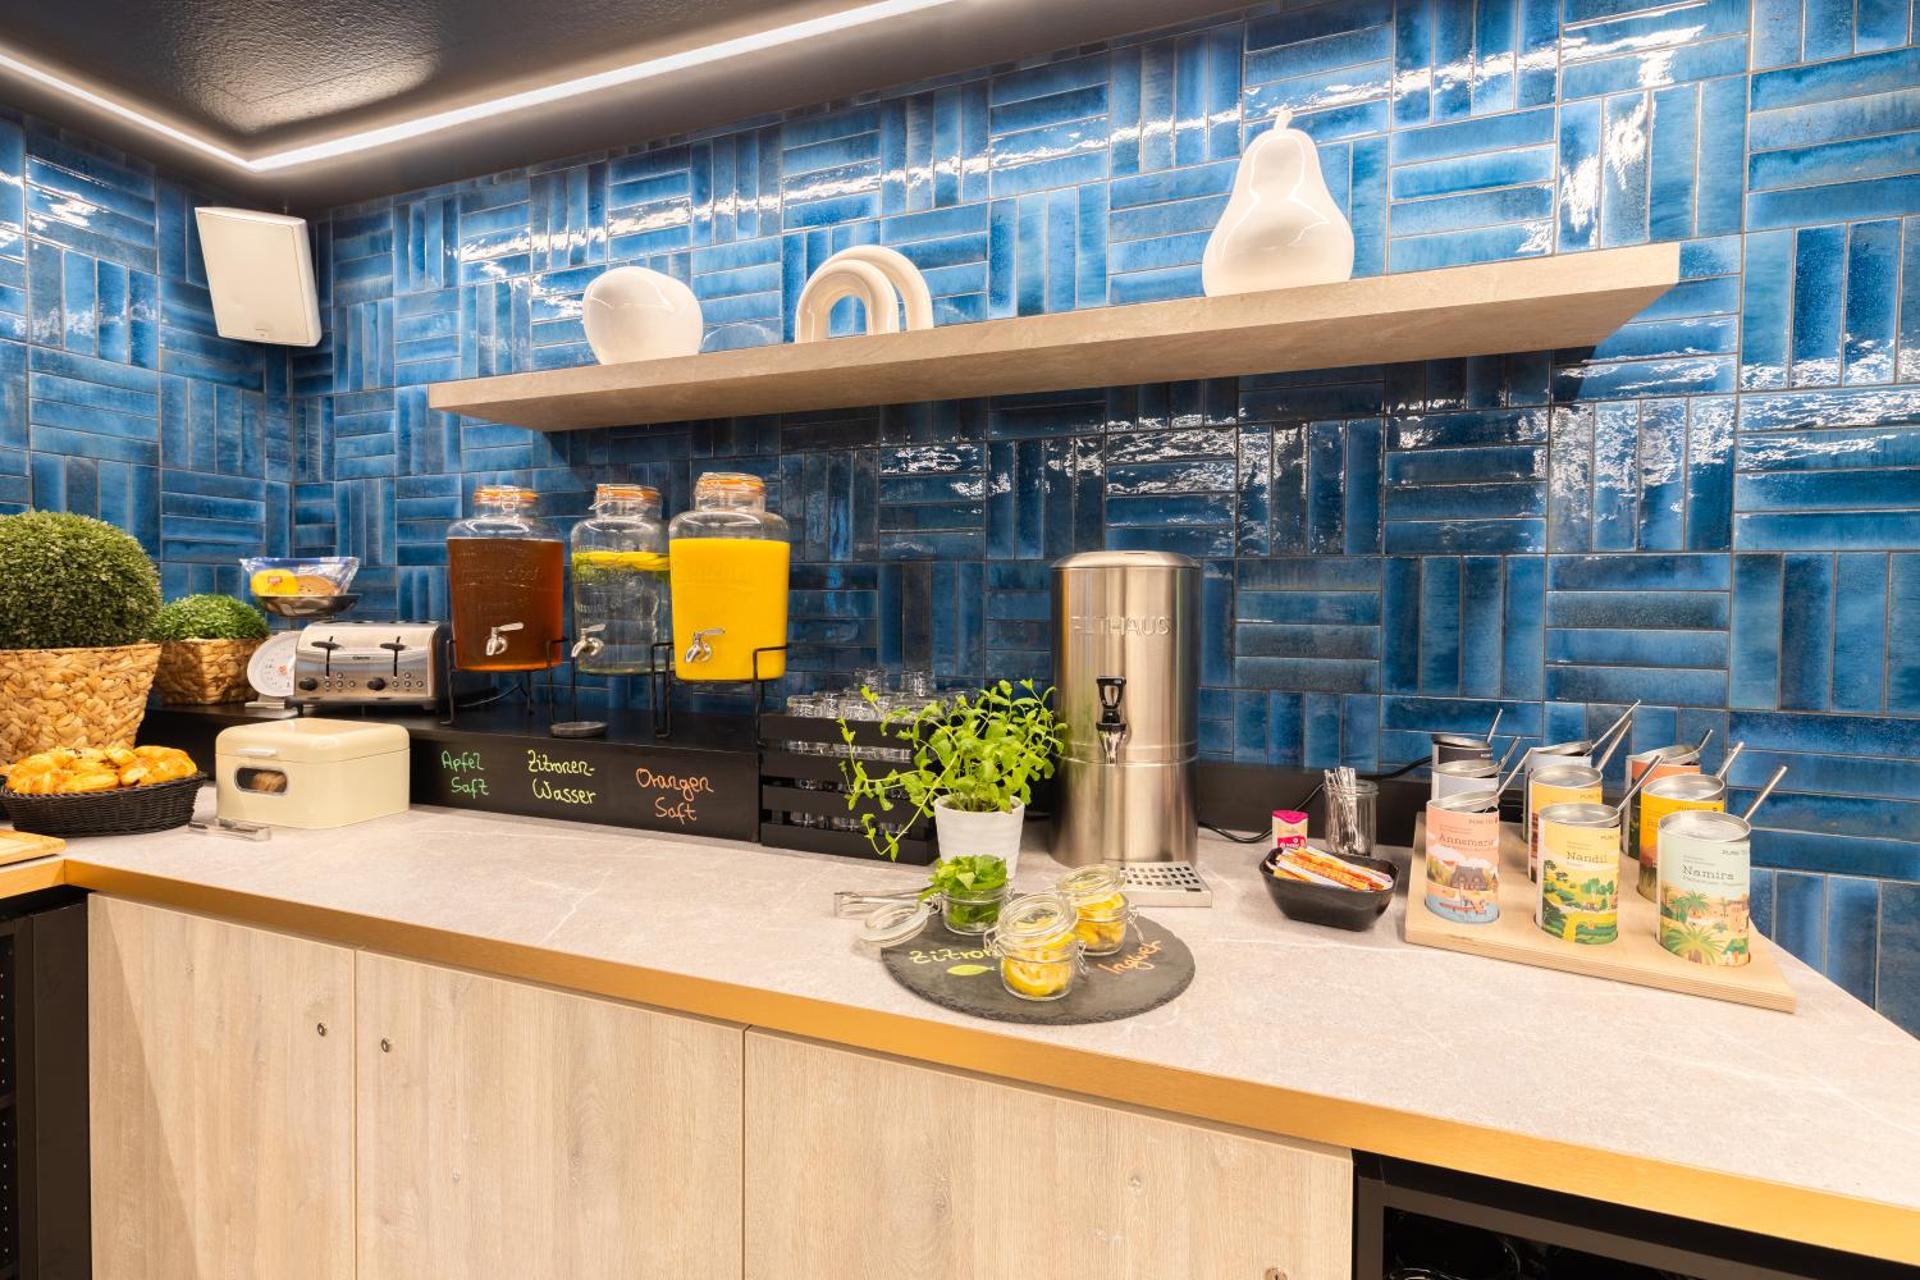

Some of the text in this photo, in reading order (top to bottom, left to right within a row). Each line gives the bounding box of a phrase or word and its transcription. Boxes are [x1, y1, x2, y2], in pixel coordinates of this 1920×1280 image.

[441, 751, 484, 770] Apfel
[528, 750, 595, 776] Zitronen-
[451, 777, 489, 799] Saft
[532, 778, 596, 805] Wasser
[636, 768, 714, 801] Orangen
[654, 796, 697, 825] Saft
